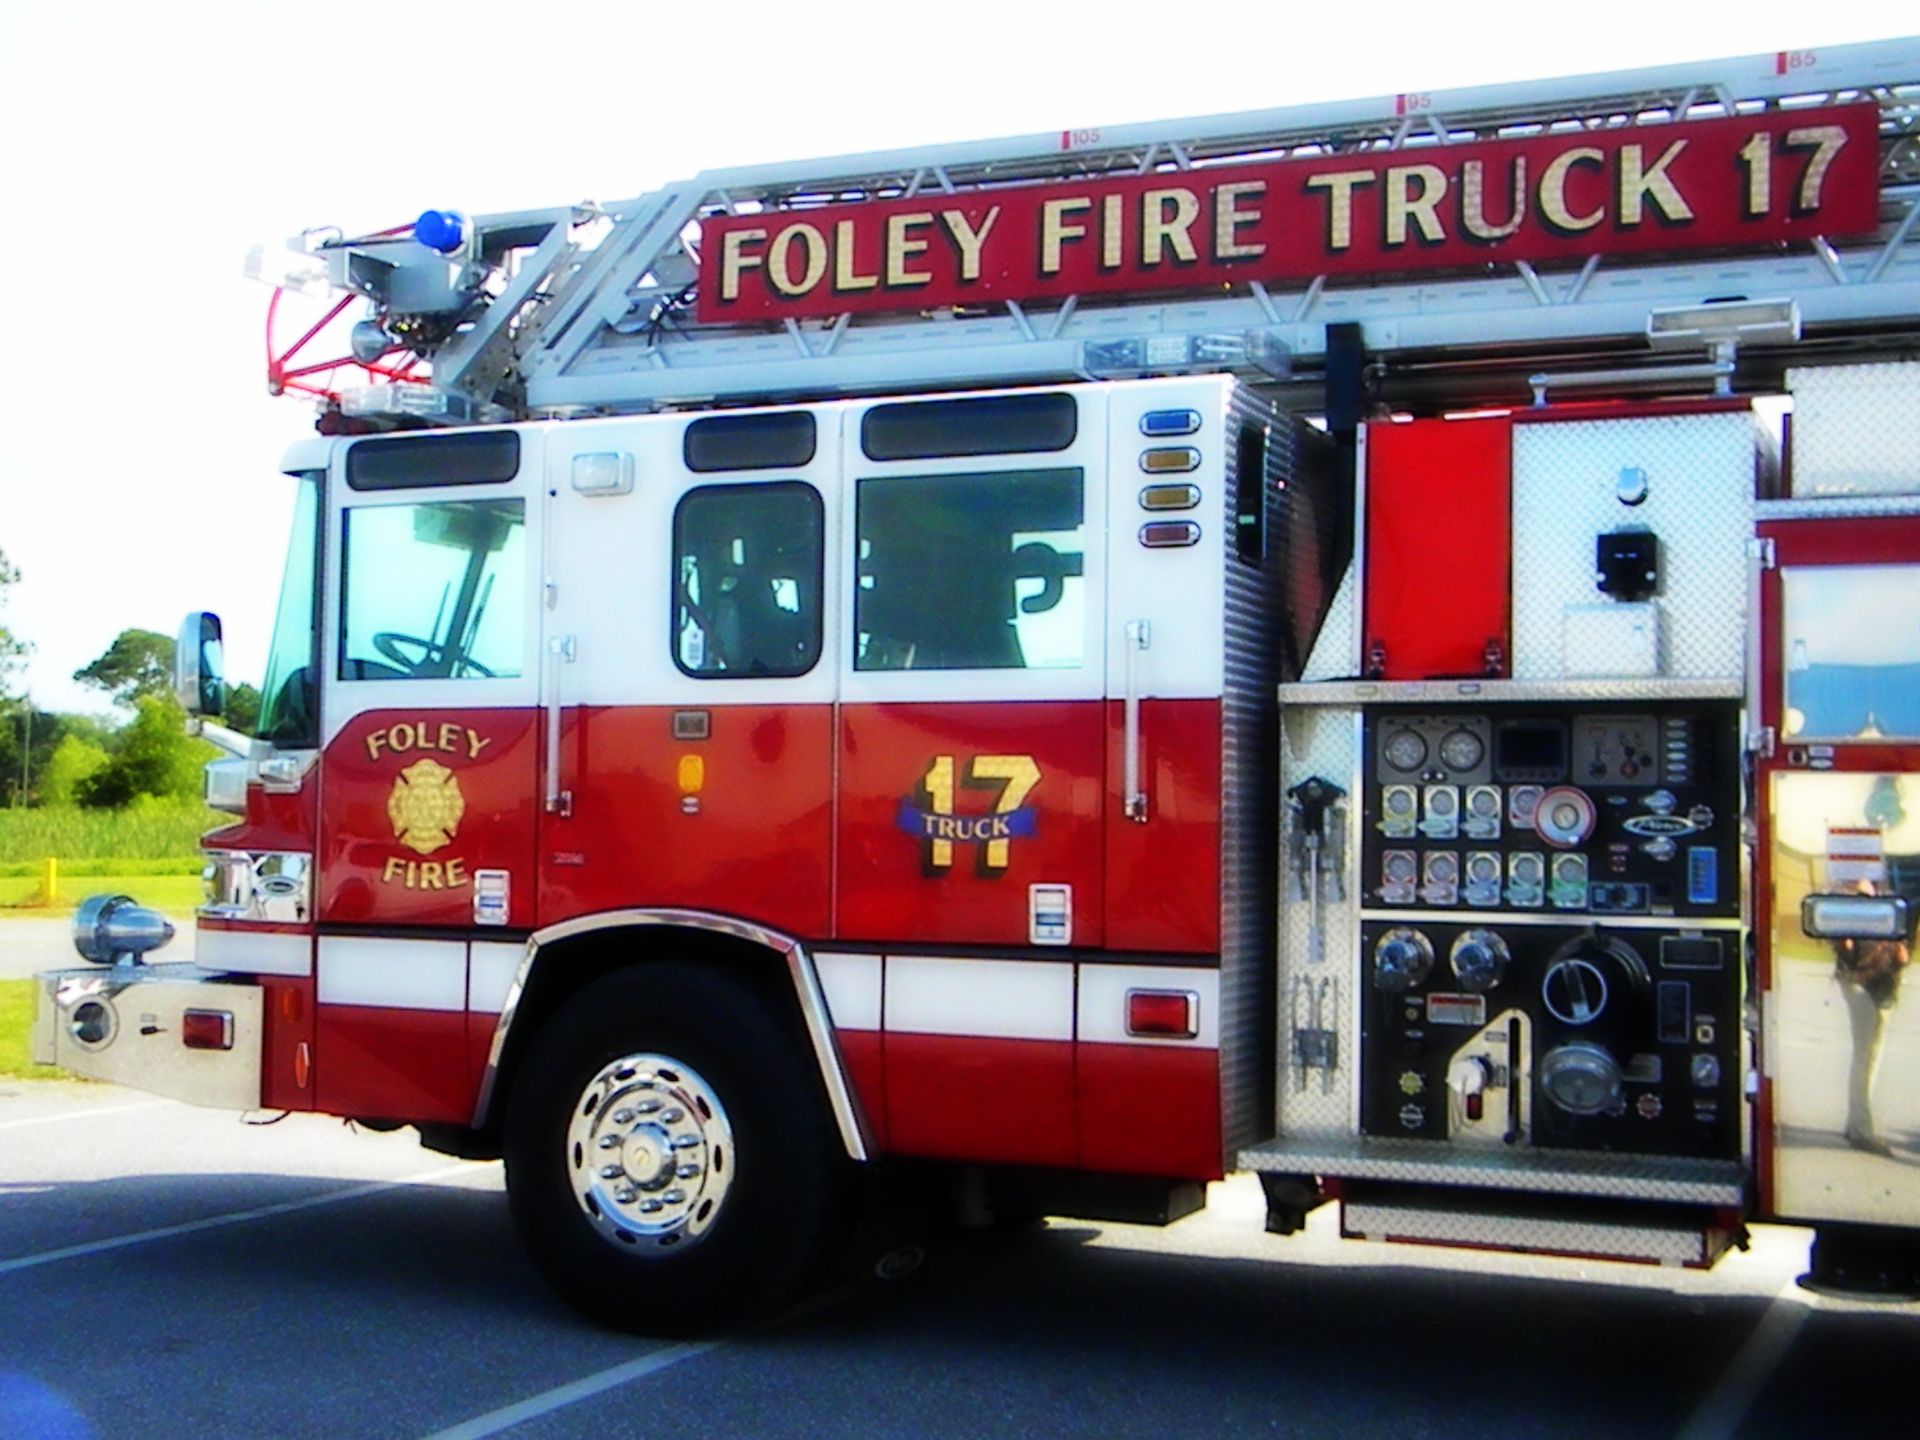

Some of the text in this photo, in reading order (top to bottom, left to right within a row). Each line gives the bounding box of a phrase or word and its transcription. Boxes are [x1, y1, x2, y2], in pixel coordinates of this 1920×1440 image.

[719, 125, 1850, 300] FOLEY FIRE TRUCK 17
[365, 721, 491, 761] FOLEY
[921, 812, 1011, 840] TRUCK
[923, 754, 1042, 868] 17
[382, 856, 469, 889] FIRE
